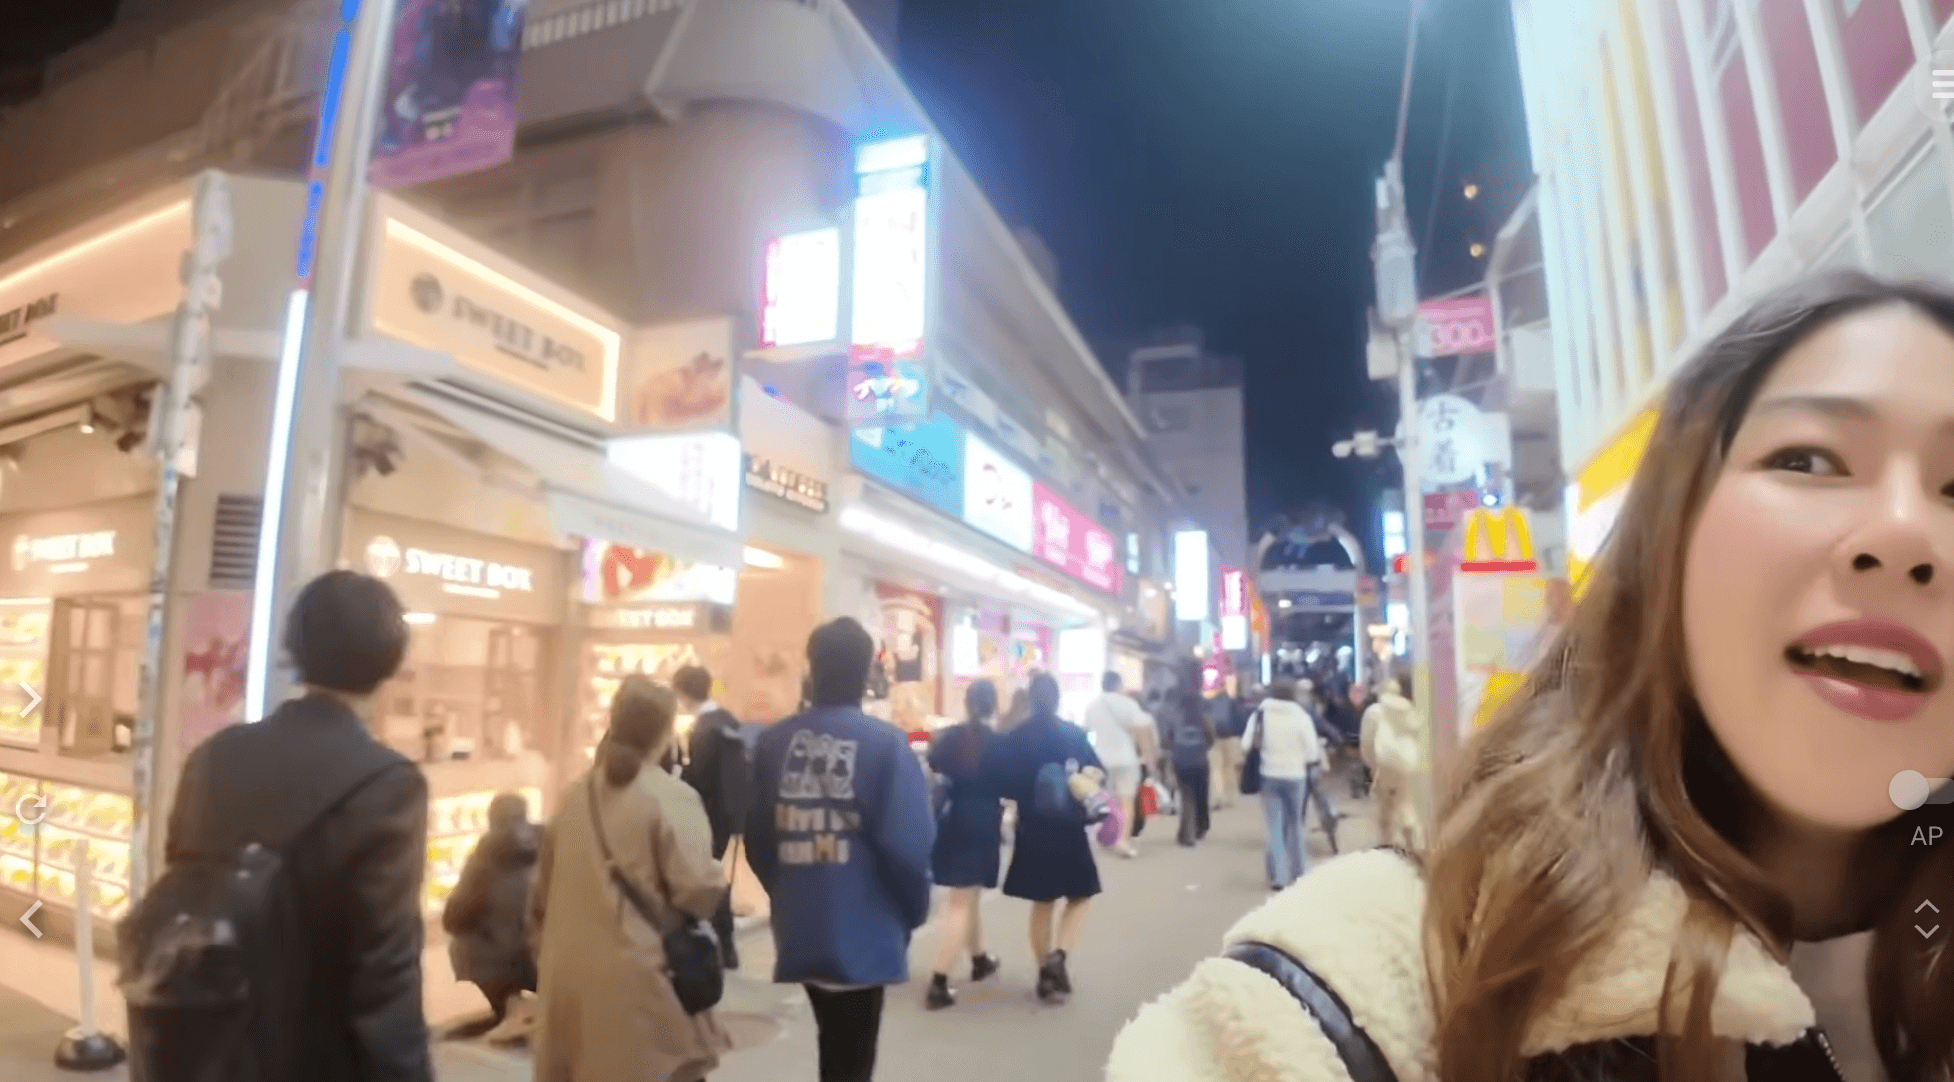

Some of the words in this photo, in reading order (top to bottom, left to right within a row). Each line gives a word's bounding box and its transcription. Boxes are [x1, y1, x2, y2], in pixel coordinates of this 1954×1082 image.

[453, 295, 534, 352] SWEET
[541, 335, 587, 374] BOX
[405, 547, 484, 583] SWEET
[486, 562, 533, 592] BOX
